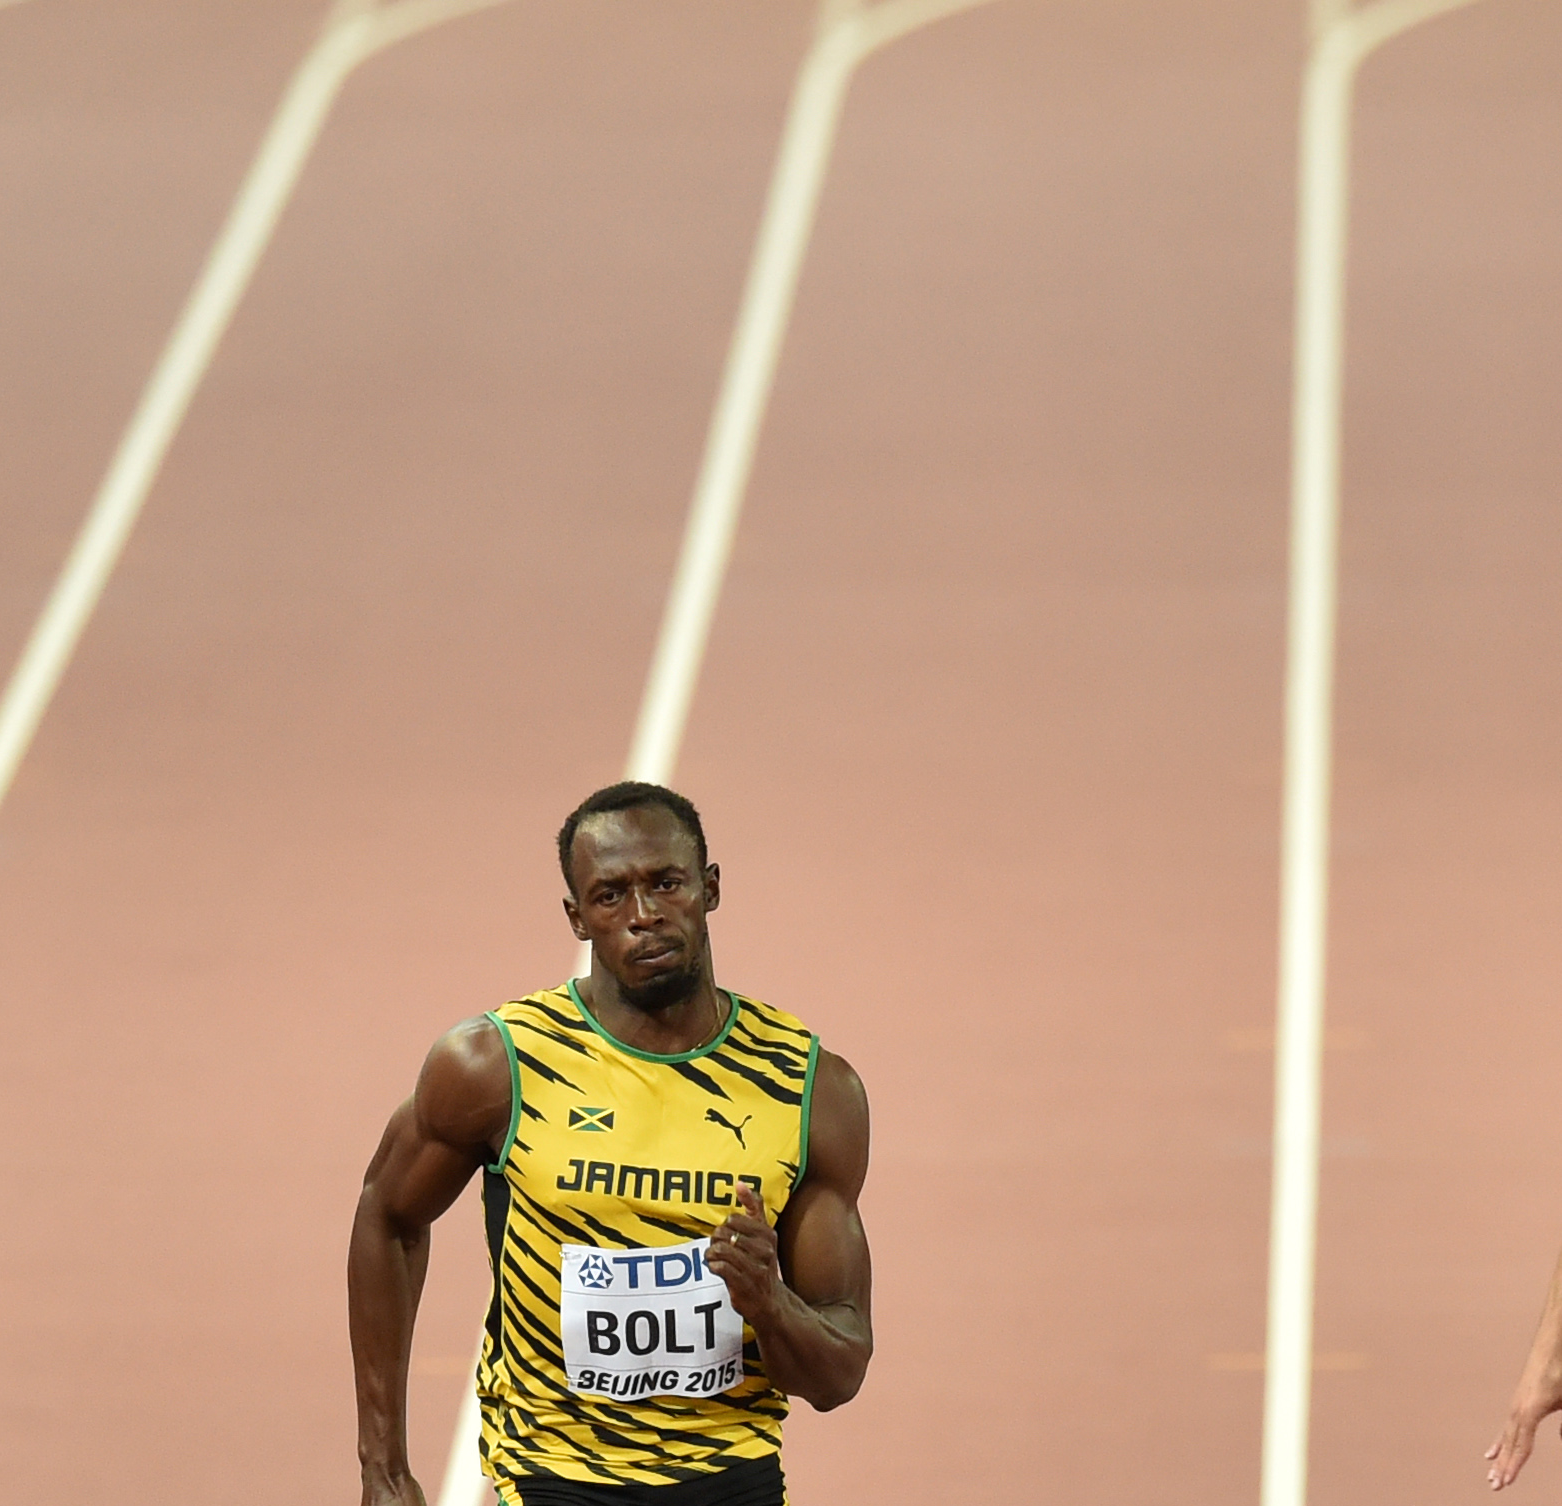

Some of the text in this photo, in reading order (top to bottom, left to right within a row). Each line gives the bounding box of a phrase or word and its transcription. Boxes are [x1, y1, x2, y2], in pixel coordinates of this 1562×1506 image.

[586, 1300, 723, 1356] BOLT
[577, 1360, 737, 1396] BEIJING 2015
